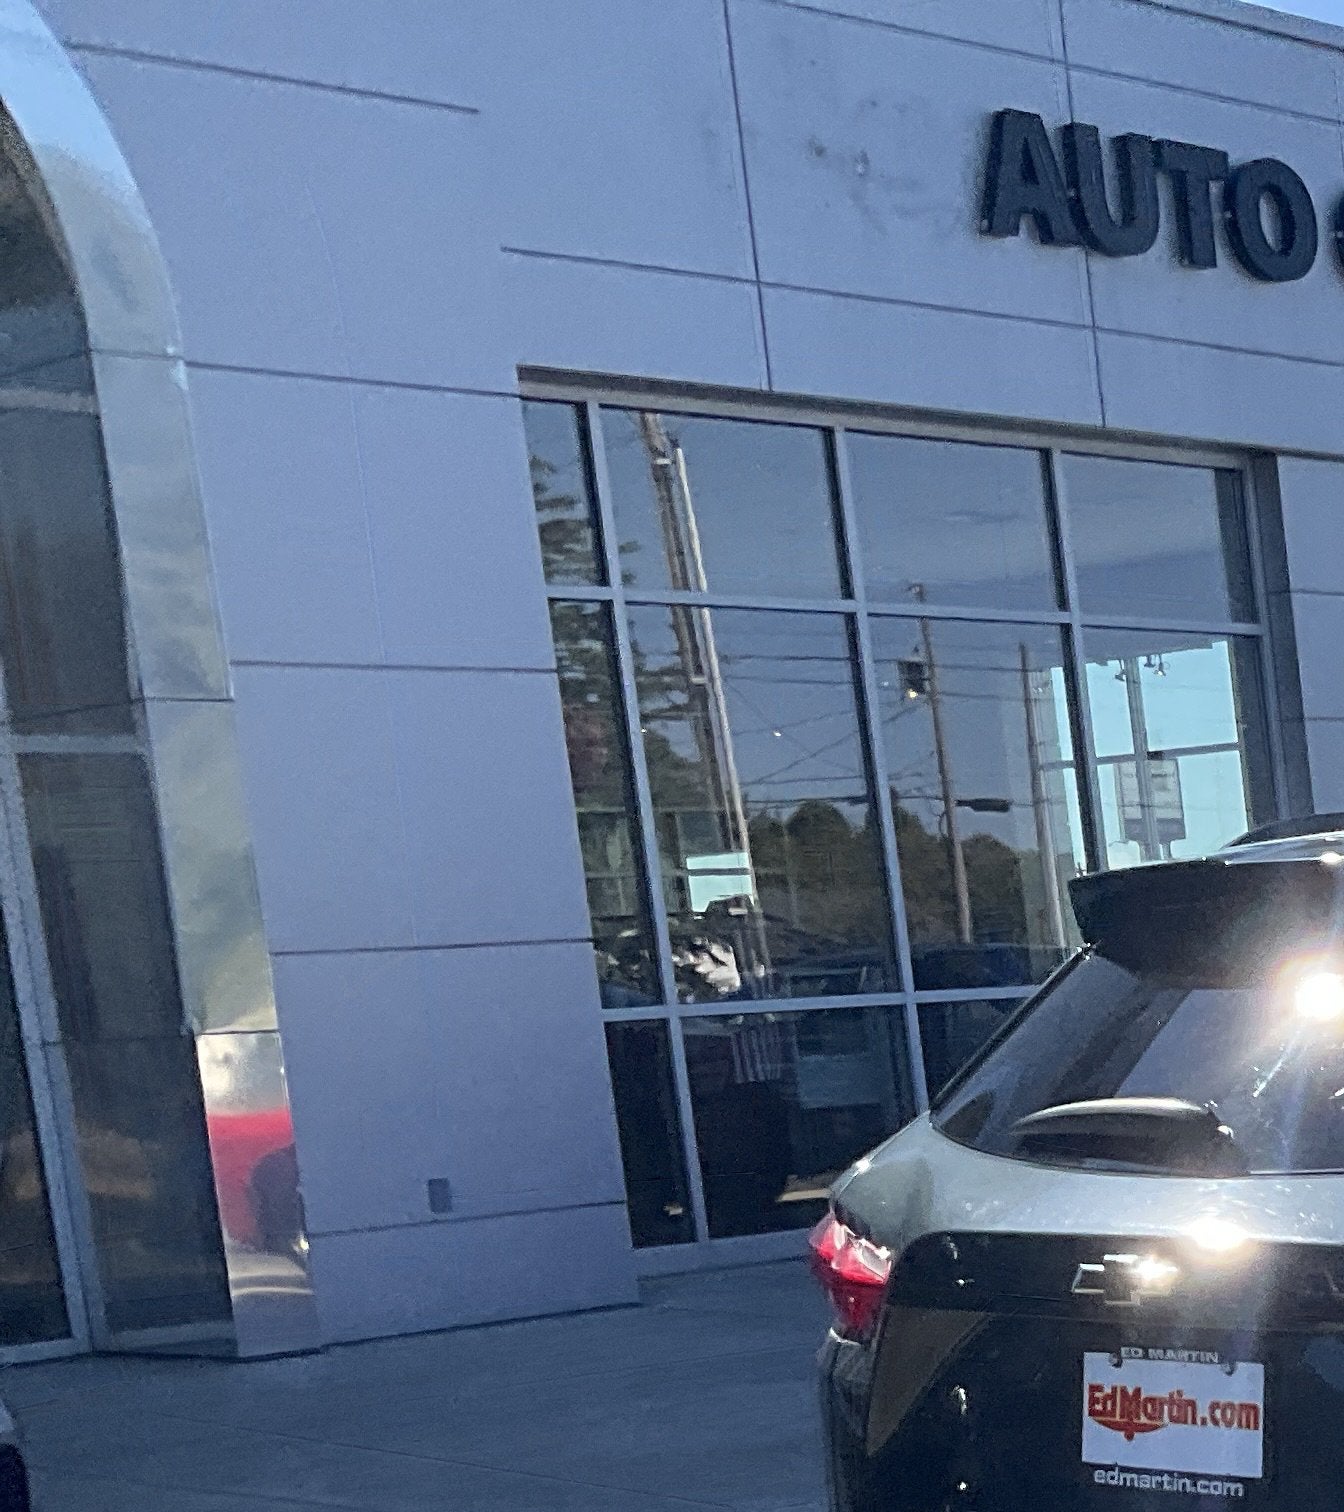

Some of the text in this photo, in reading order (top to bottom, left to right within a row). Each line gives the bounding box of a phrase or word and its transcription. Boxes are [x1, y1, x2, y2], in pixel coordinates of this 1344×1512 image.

[980, 108, 1318, 283] AUTO
[1121, 1347, 1219, 1364] ED MARTIN
[1087, 1383, 1260, 1431] EdMartin.com
[1094, 1466, 1245, 1498] edmartin.com
